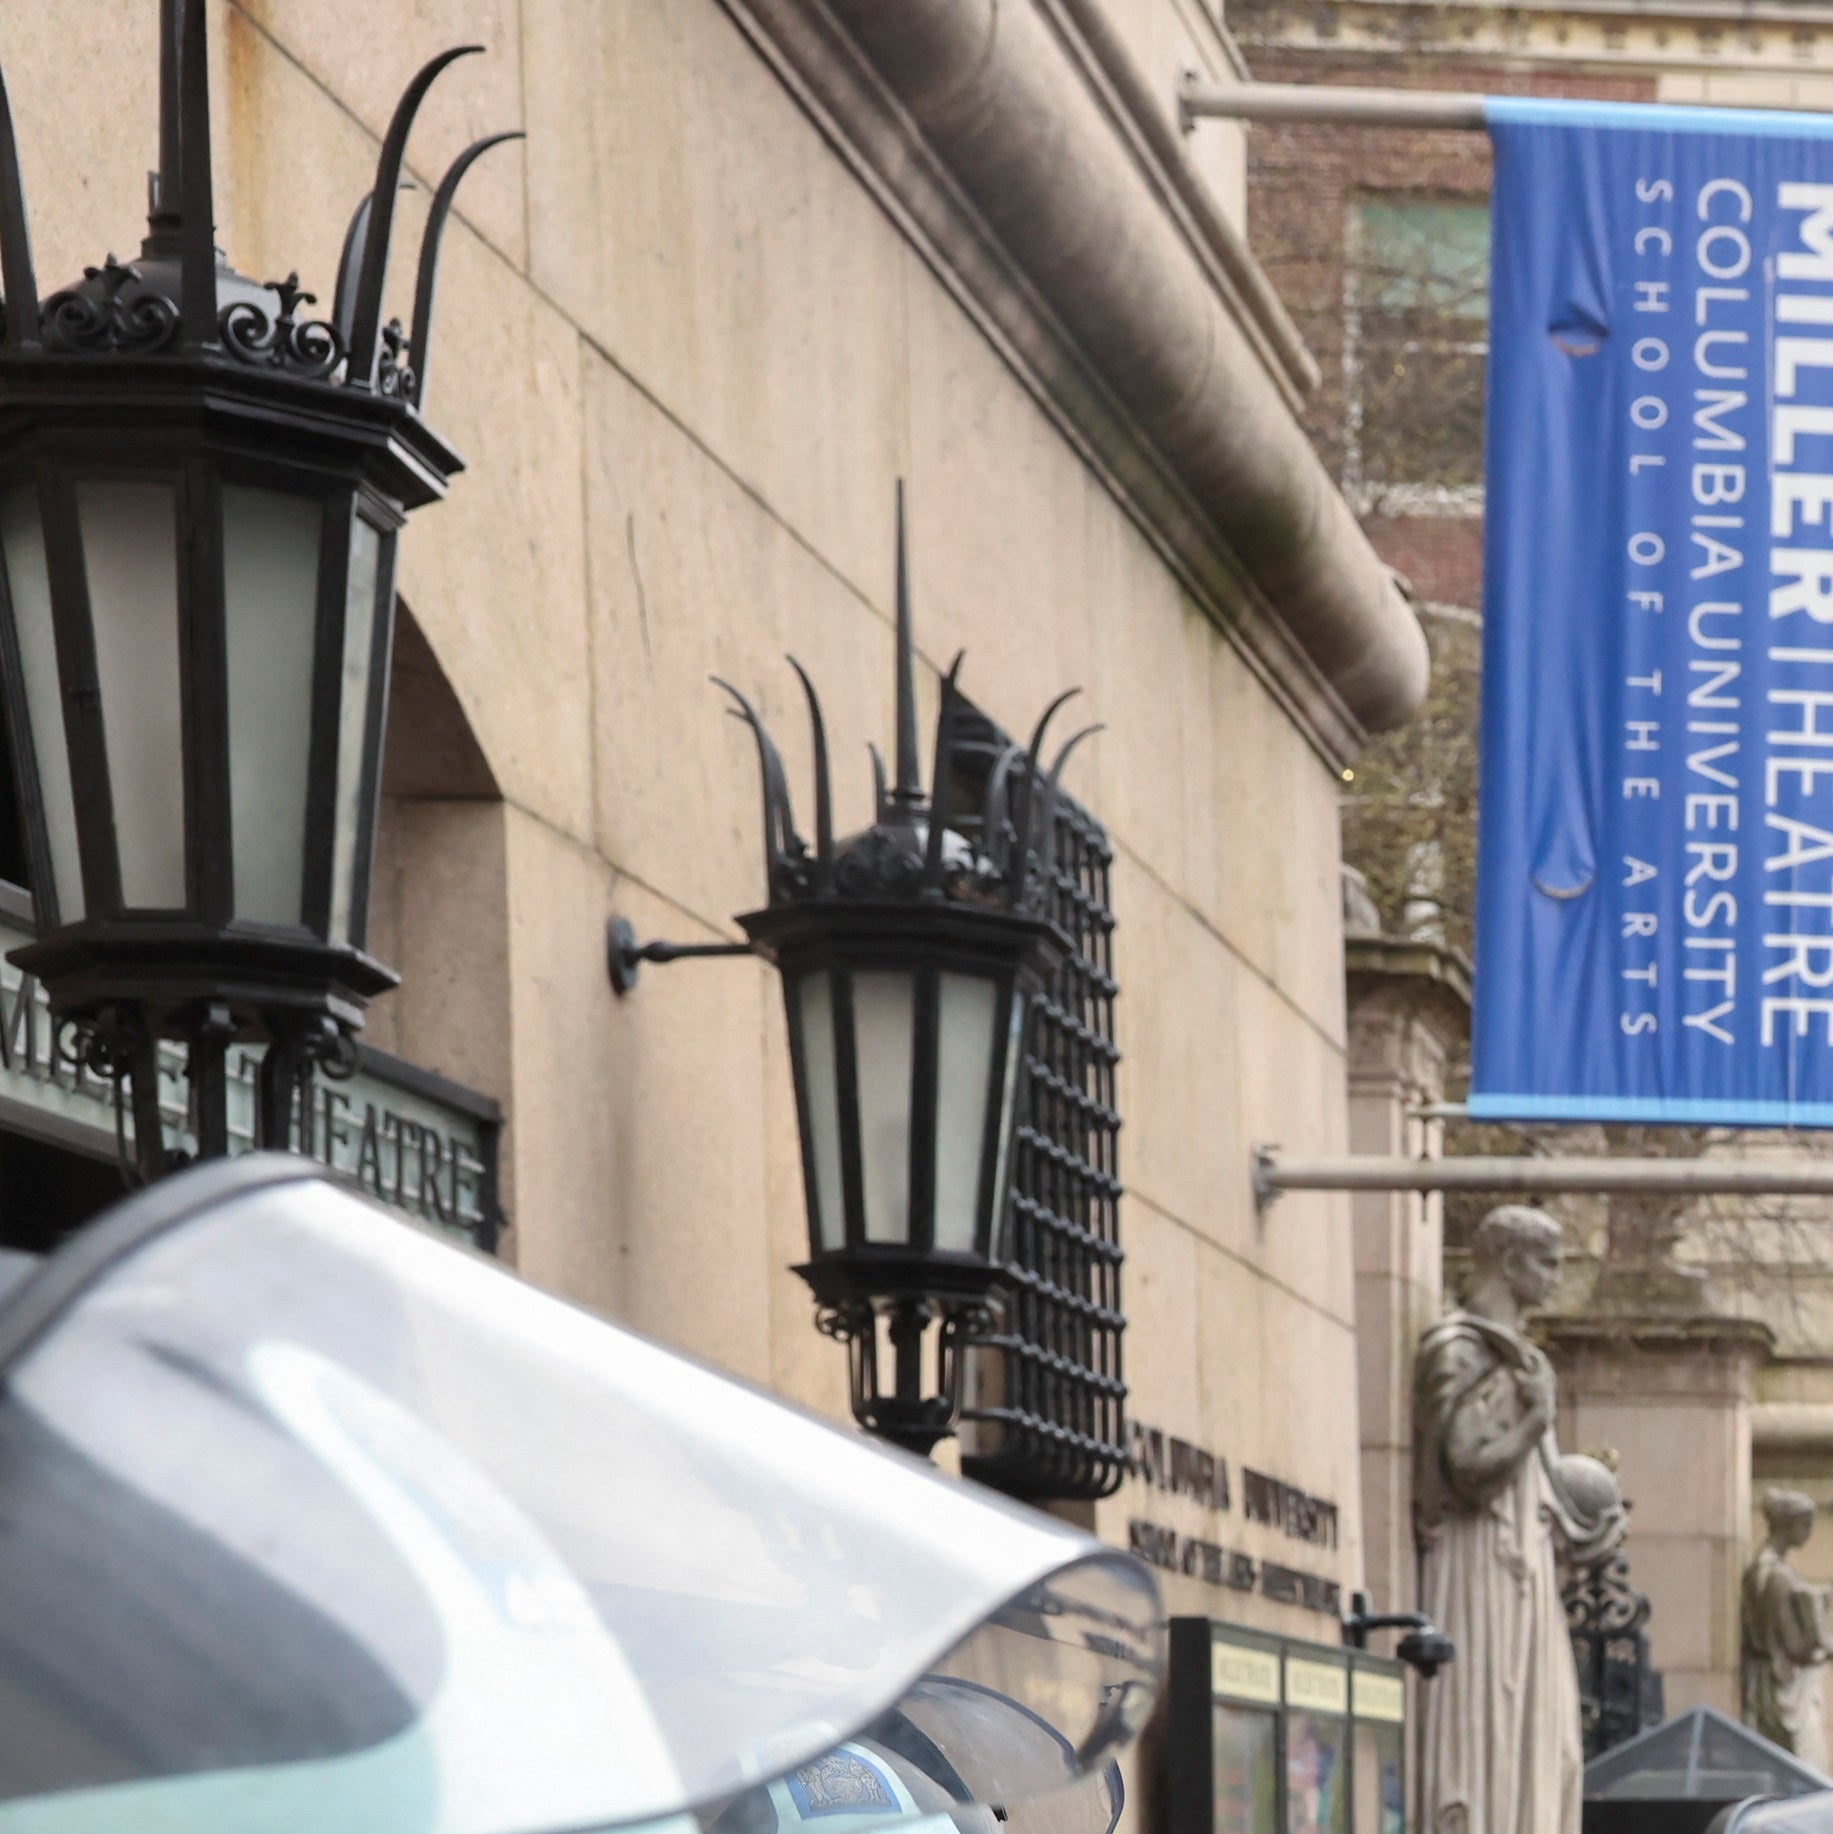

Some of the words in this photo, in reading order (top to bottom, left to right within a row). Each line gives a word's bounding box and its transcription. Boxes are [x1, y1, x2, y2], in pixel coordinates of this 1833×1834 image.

[1628, 178, 1673, 476] SCHOOL
[1692, 179, 1752, 580] COLUMBIA
[1625, 531, 1666, 613] OF
[1622, 670, 1663, 800] THE
[1683, 604, 1746, 1047] UNIVERSITY
[1620, 856, 1659, 1037] ARTS
